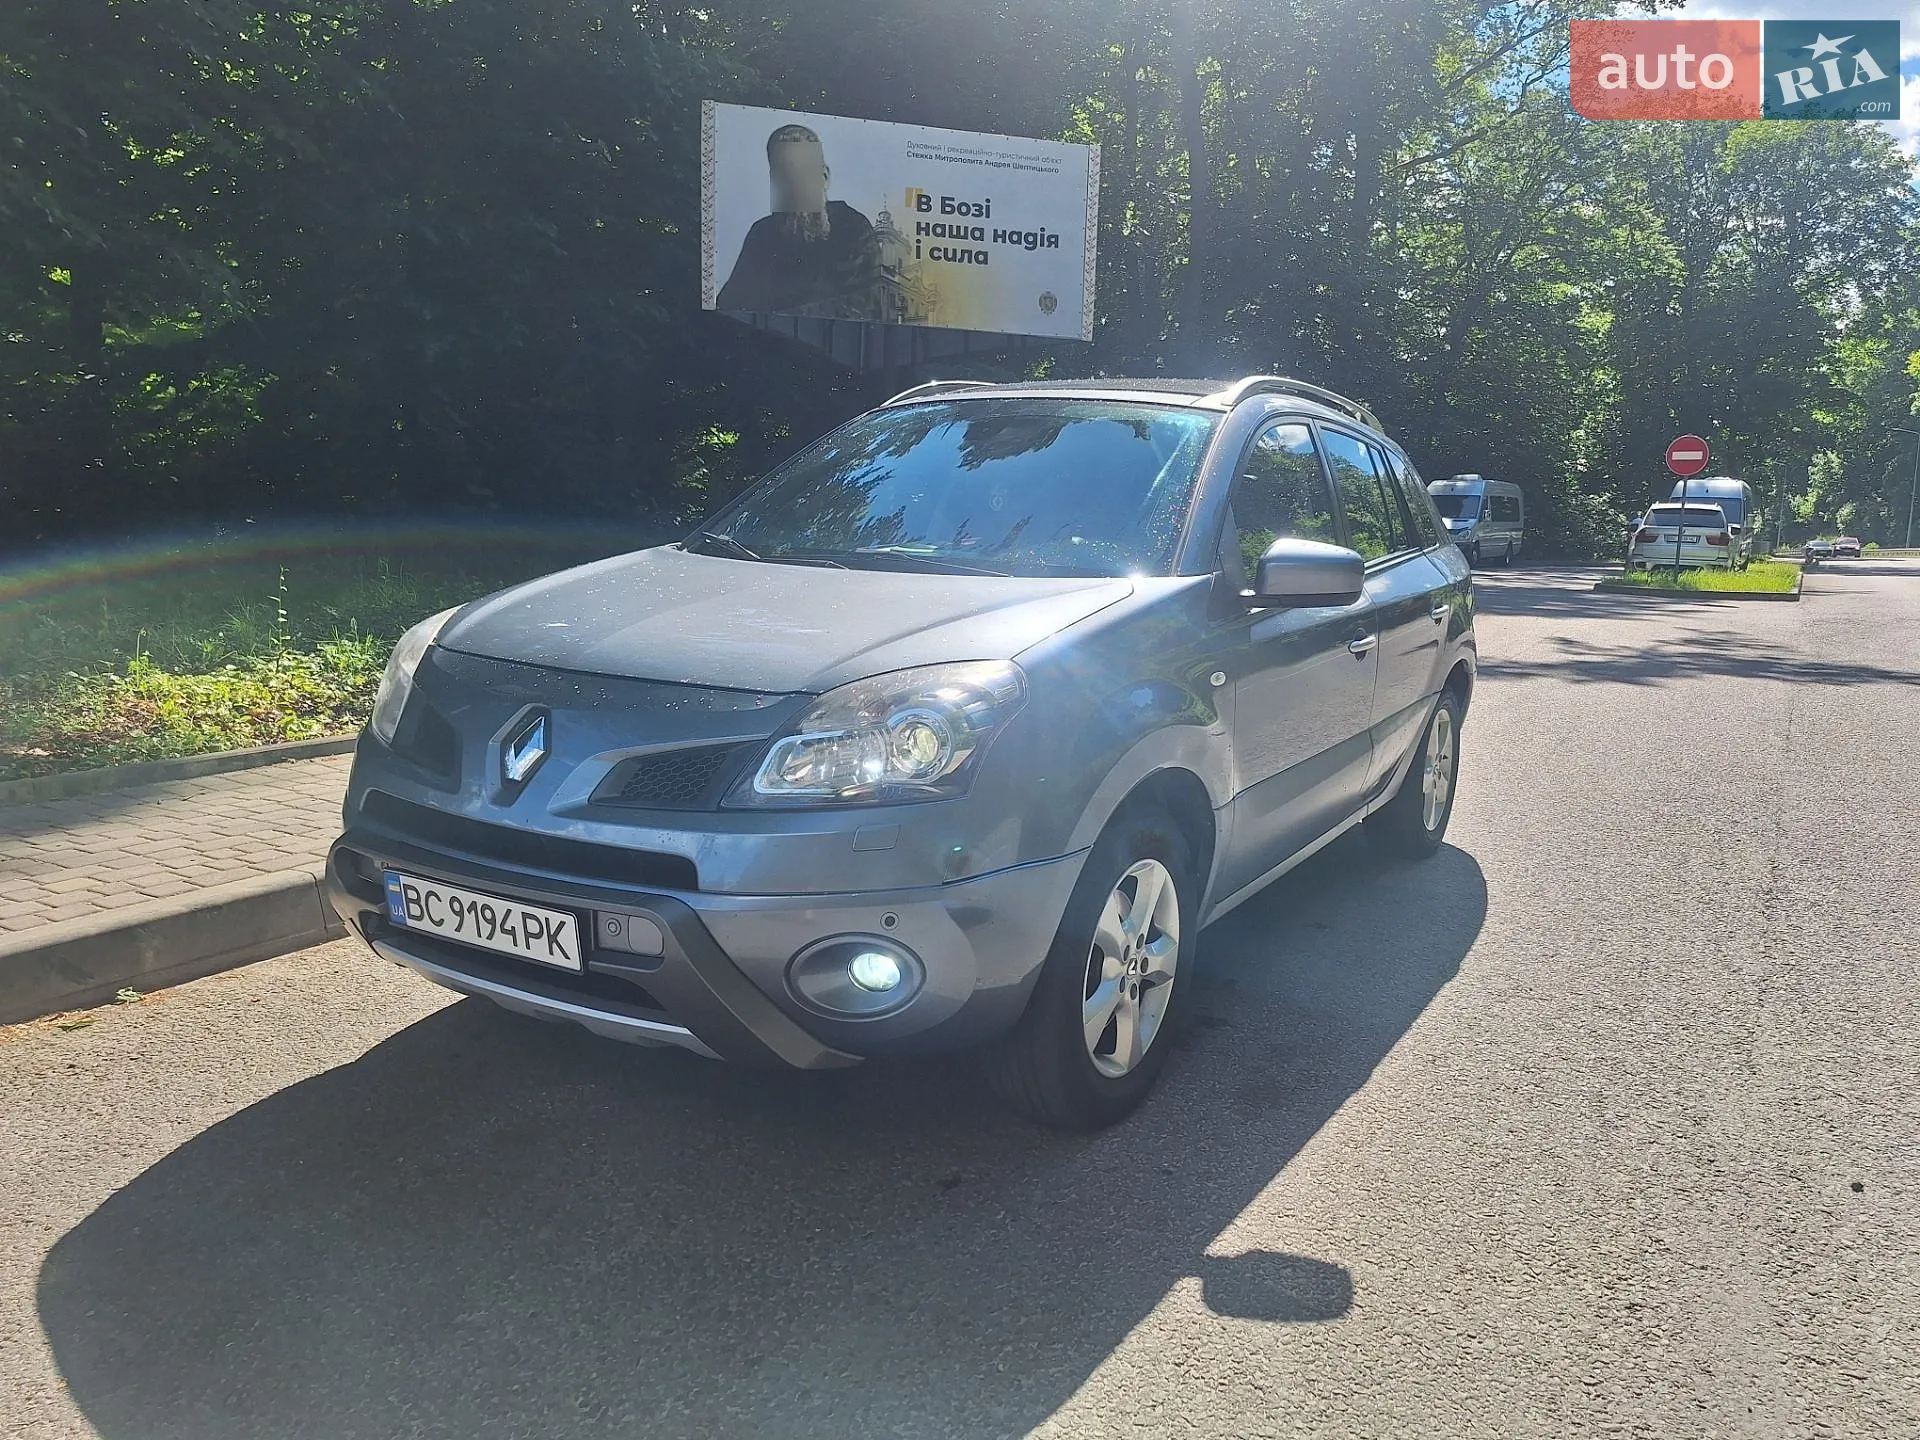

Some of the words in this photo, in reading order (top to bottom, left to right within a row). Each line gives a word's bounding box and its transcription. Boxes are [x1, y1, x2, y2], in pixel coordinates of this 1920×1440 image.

[906, 140, 942, 151] Духовний
[906, 151, 933, 160] Стежка
[935, 154, 983, 166] Митрополита
[984, 160, 1011, 169] Андрея
[1012, 162, 1060, 174] Шептицького
[940, 196, 991, 219] Бозі
[916, 221, 985, 242] наша
[992, 227, 1060, 251] надія
[915, 238, 922, 260] і
[928, 246, 989, 265] сила
[392, 905, 405, 917] UA
[402, 883, 444, 927] BC
[449, 895, 519, 948] 9194
[521, 911, 571, 960] PK
